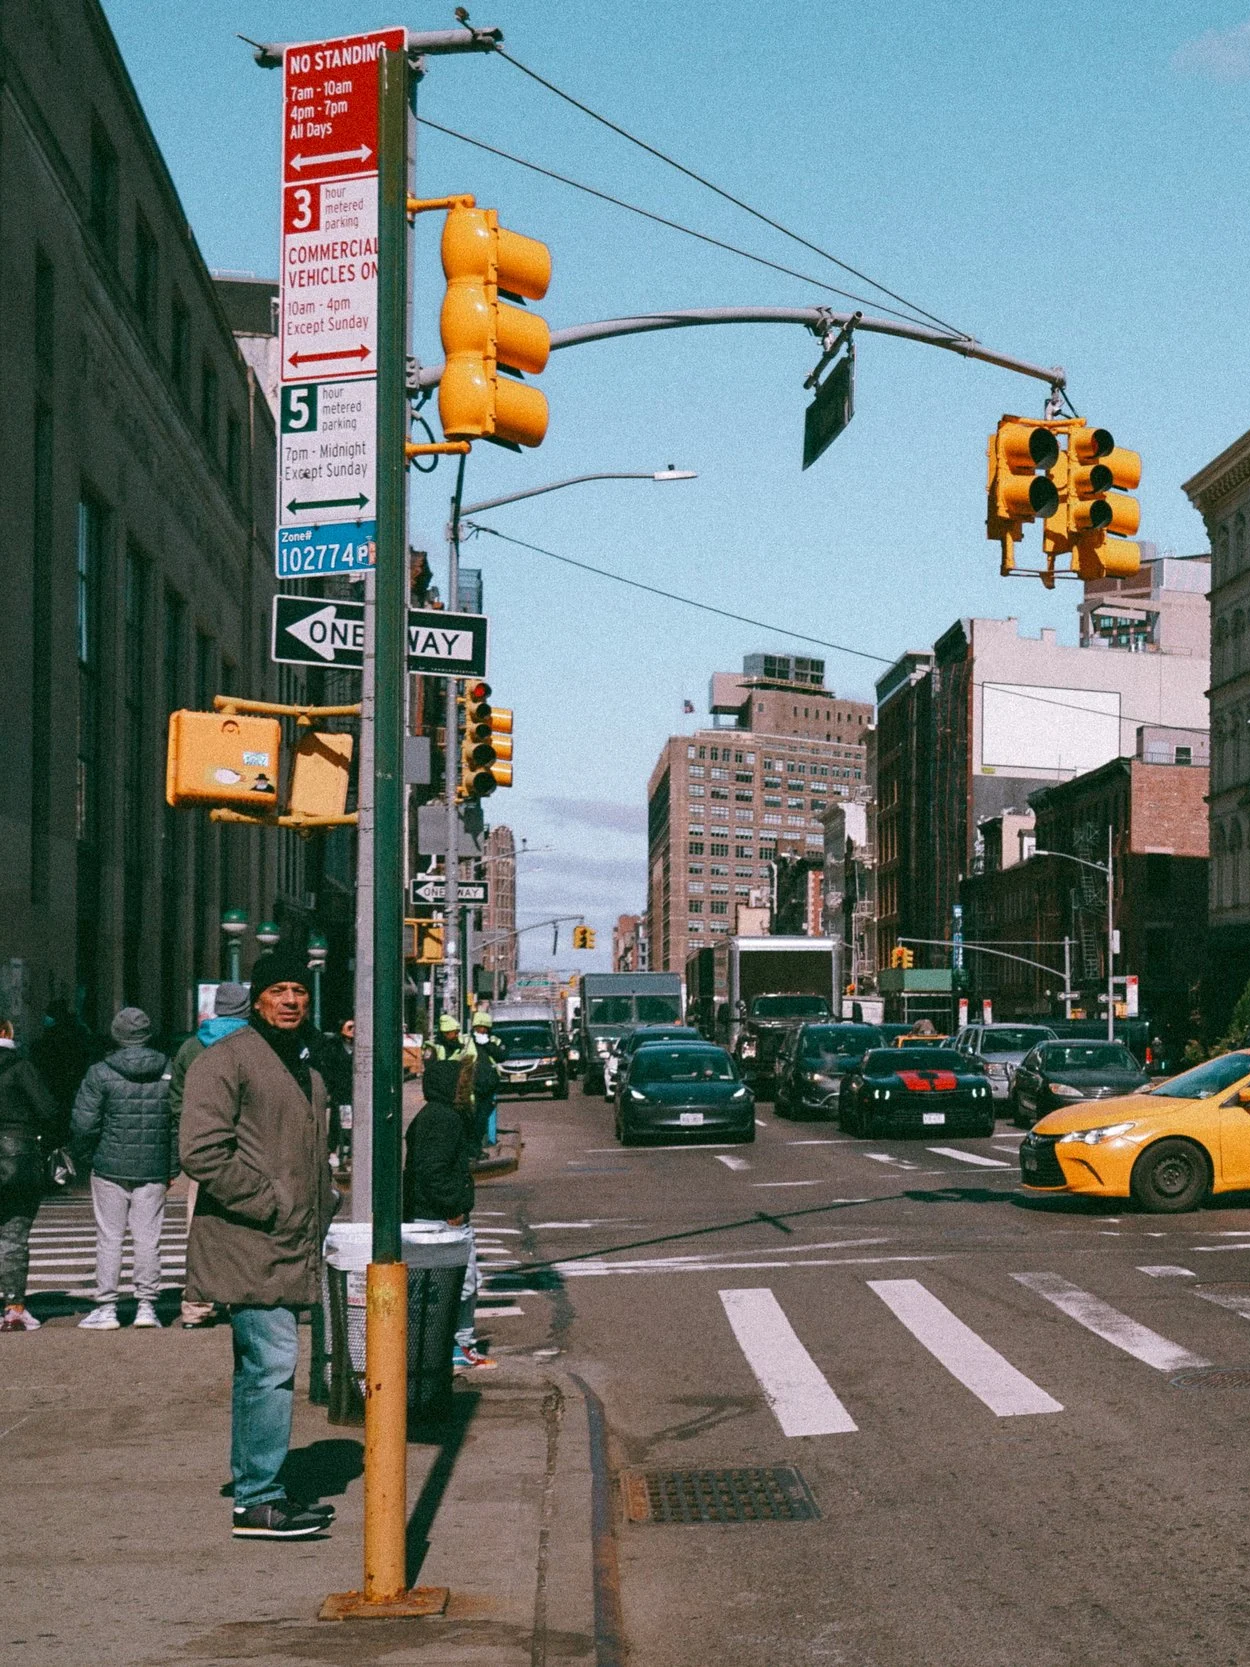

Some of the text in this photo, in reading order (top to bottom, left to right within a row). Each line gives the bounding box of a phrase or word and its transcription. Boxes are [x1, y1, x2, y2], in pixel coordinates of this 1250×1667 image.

[290, 54, 311, 75] NO
[290, 86, 314, 101] 7am
[324, 80, 352, 96] 10am
[290, 105, 315, 122] 4pm
[325, 101, 348, 116] 7pm
[290, 121, 333, 140] All Days
[325, 186, 346, 199] hour
[292, 189, 312, 229] 3
[325, 199, 364, 213] metered
[324, 214, 359, 231] parking
[288, 237, 379, 265] COMMERCIAL
[288, 264, 356, 289] VEHICLES
[287, 298, 315, 316] 10am
[327, 297, 351, 315] 4pm
[287, 314, 369, 337] Except Sunday
[322, 386, 345, 399] hour
[288, 388, 309, 430] 5
[322, 401, 362, 414] metered
[322, 419, 357, 433] parking
[285, 447, 309, 463] 7pm
[320, 441, 367, 459] Midnight
[285, 461, 368, 482] Except Sunday
[281, 531, 312, 543] Zone#
[281, 543, 354, 573] 102774
[309, 619, 364, 648] ONE
[424, 888, 446, 898] ONE
